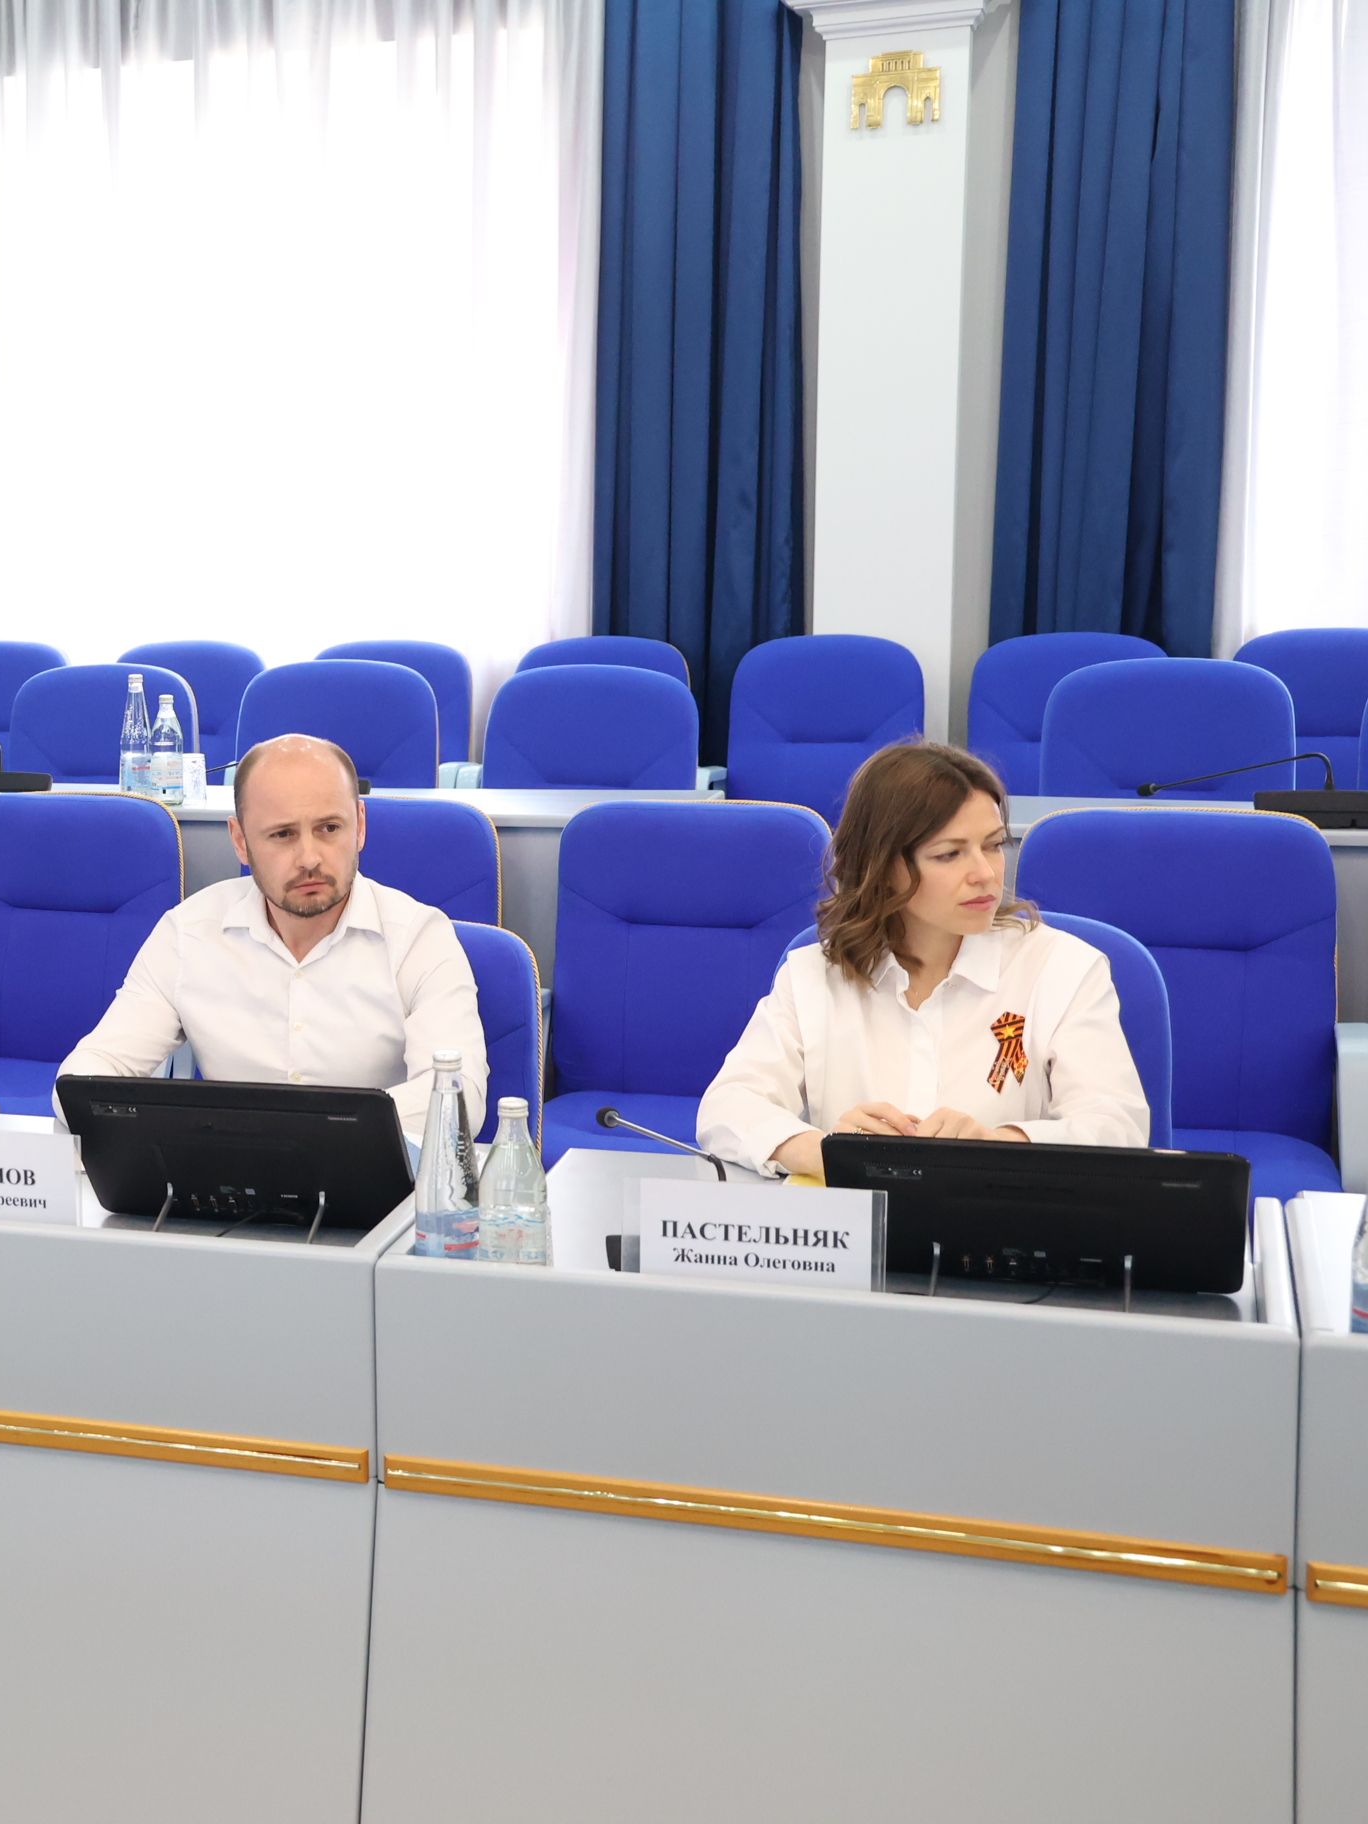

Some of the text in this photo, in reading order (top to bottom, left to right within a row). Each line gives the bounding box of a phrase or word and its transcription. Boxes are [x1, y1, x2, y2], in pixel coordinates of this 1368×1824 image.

[660, 1219, 850, 1250] ПАСТЕЛЬНЯК
[673, 1247, 836, 1273] Жанна Олеговна
